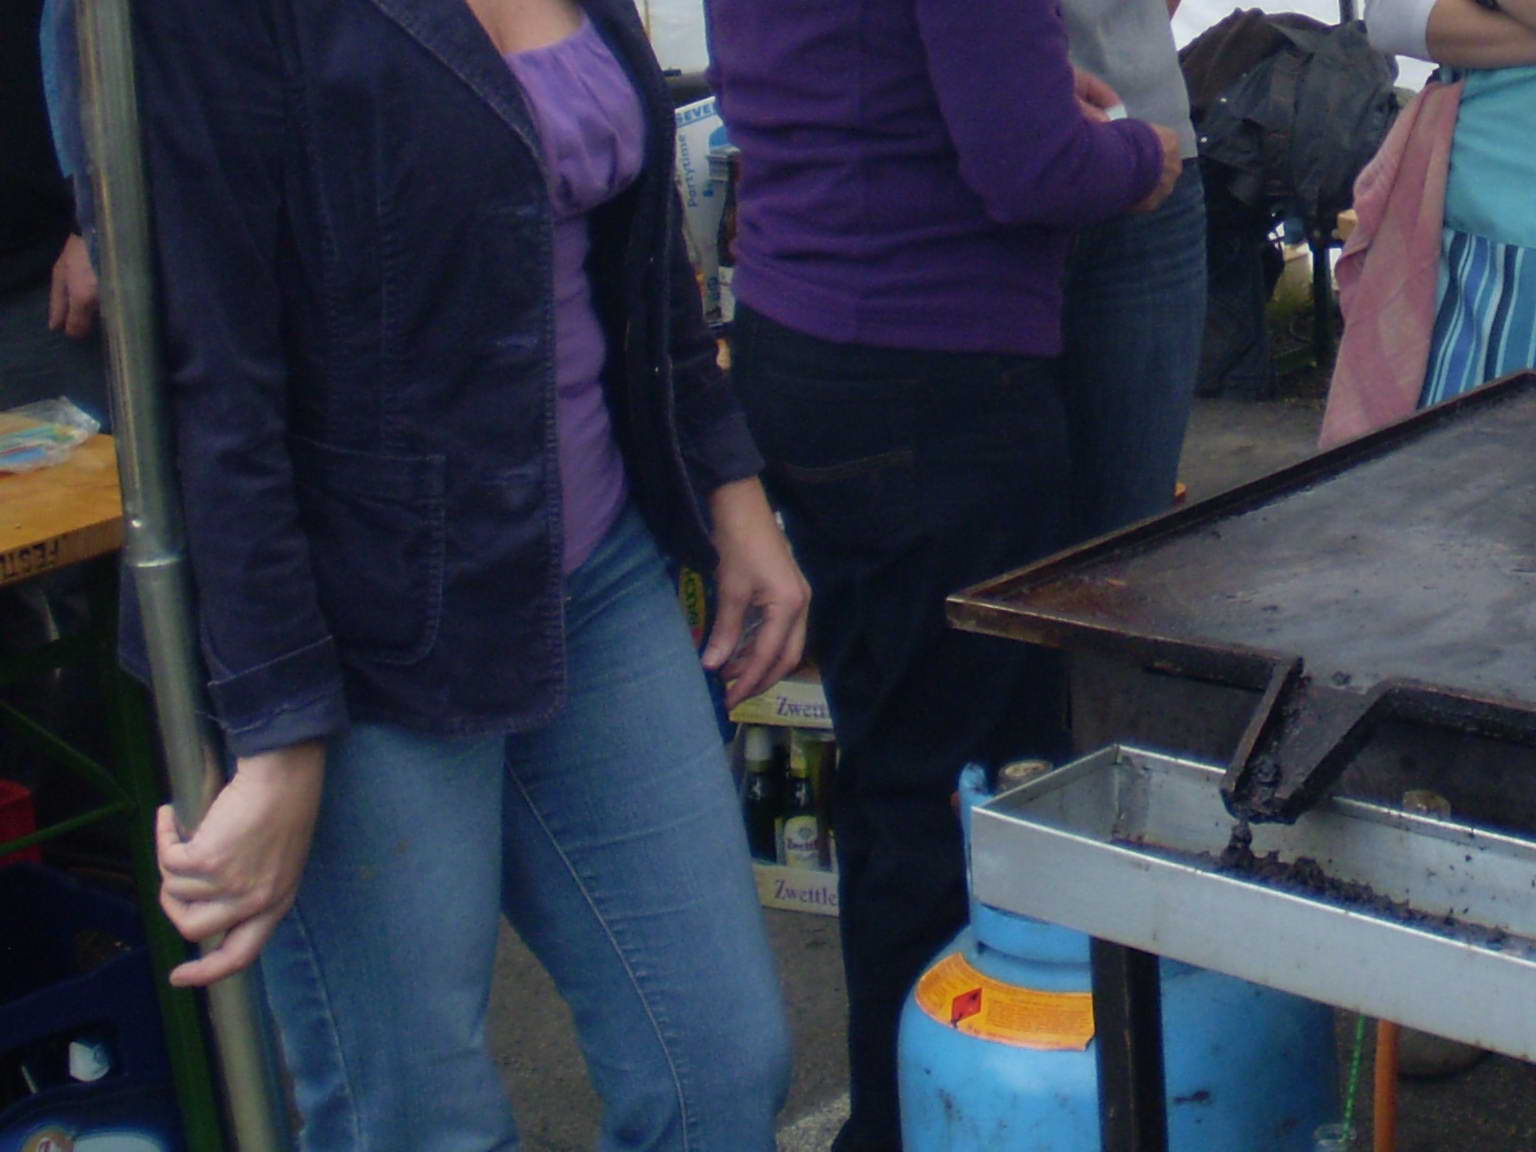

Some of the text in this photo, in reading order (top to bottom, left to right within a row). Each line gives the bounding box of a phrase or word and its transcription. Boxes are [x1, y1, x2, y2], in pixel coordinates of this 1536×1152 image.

[675, 102, 715, 125] SEVE
[776, 695, 830, 719] Zwett
[774, 879, 838, 904] Zwettle
